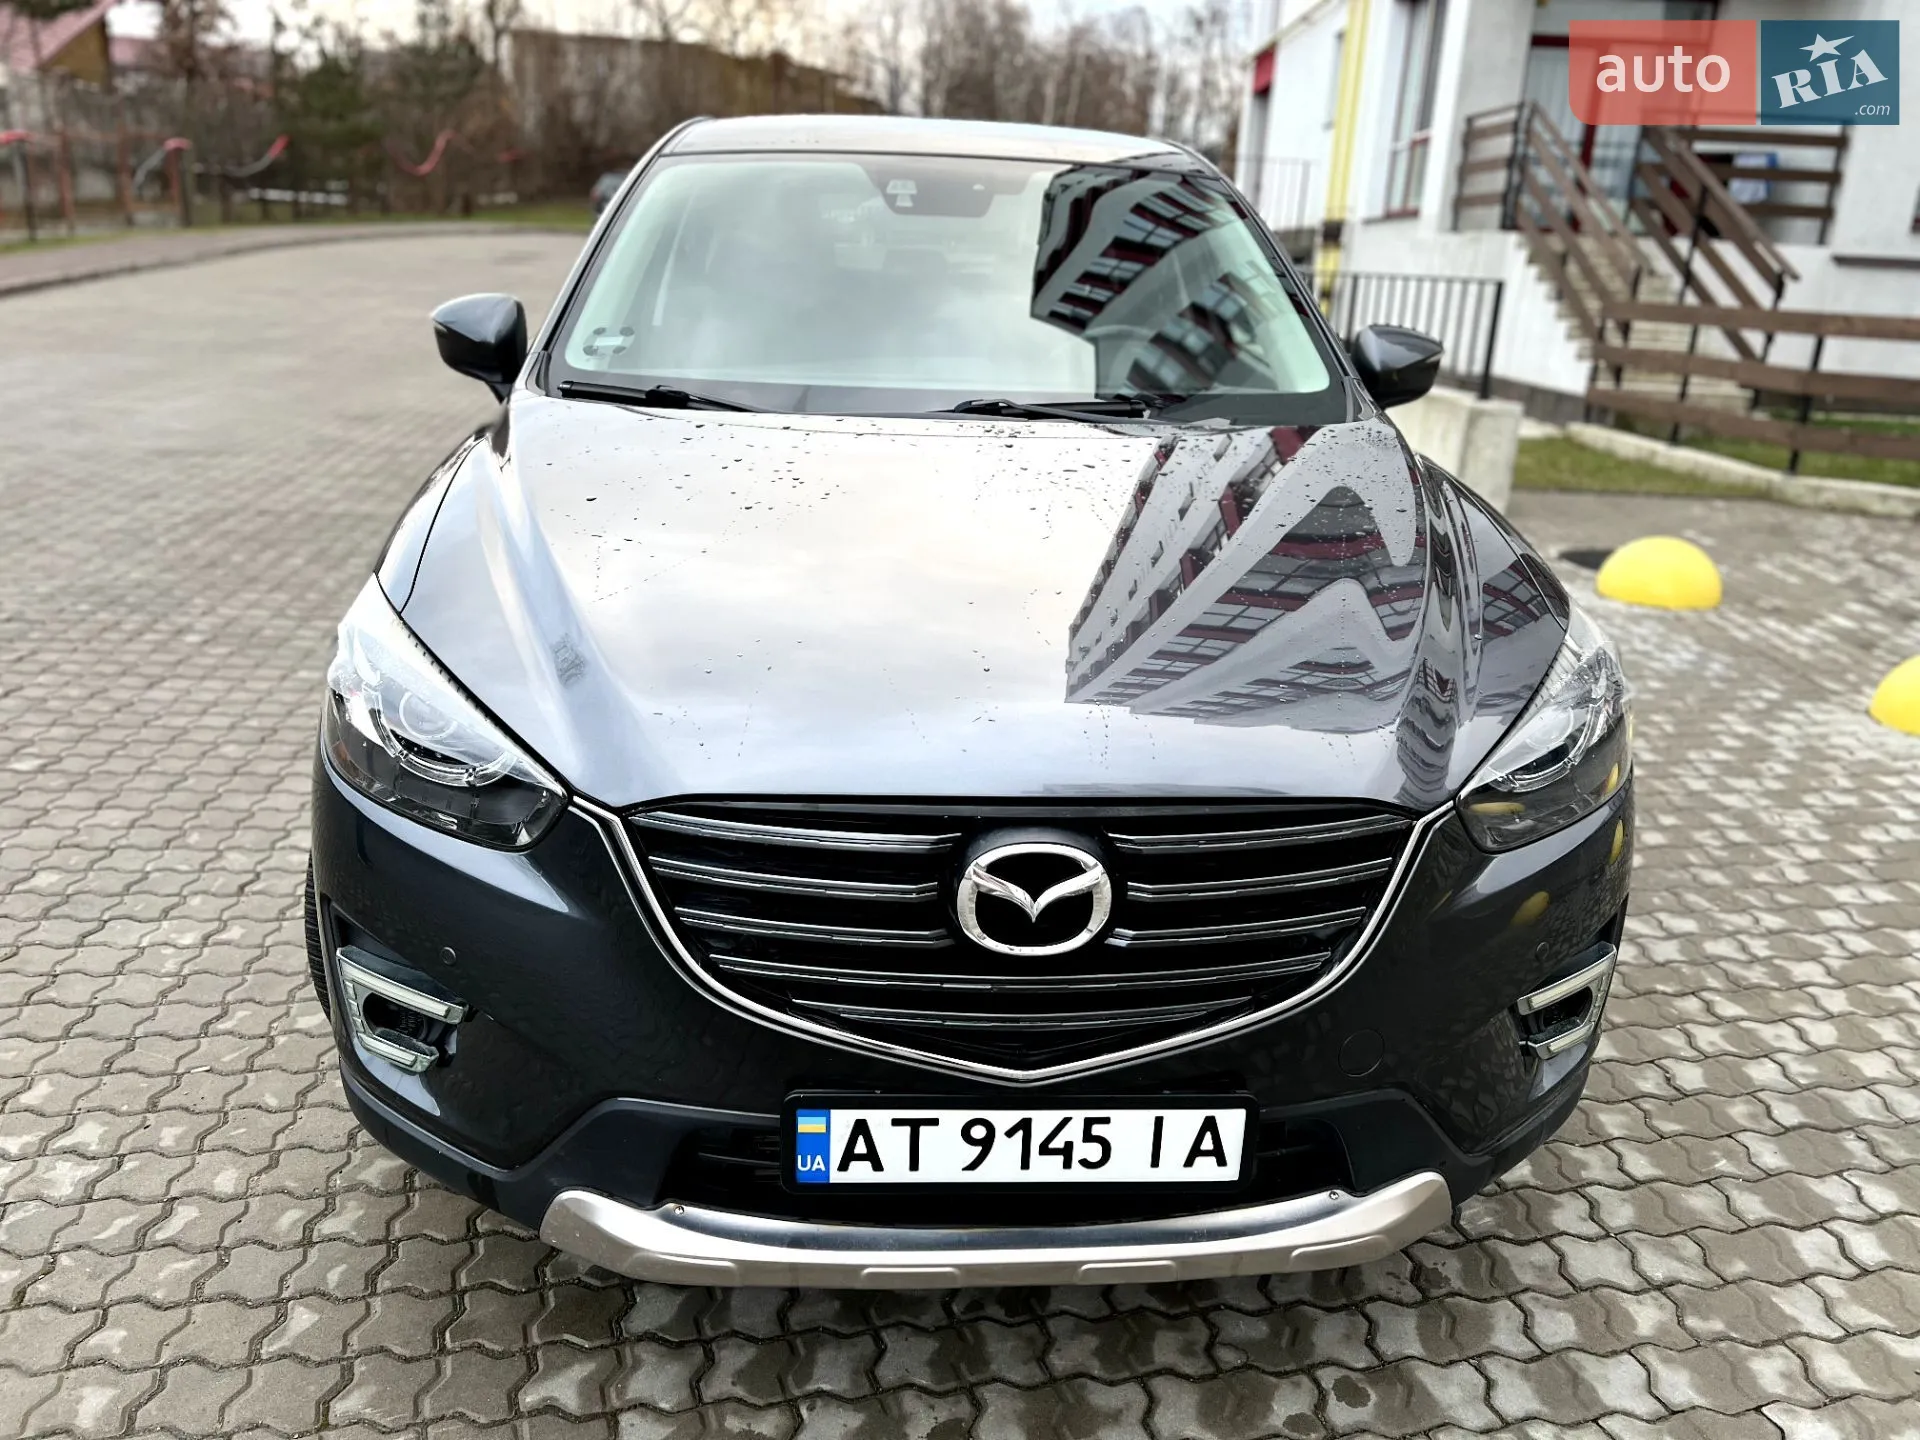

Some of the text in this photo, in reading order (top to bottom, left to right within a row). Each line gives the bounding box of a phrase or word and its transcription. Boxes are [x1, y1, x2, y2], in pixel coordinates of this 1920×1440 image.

[836, 1114, 1228, 1172] AT 9145 IA
[797, 1154, 826, 1172] UA
